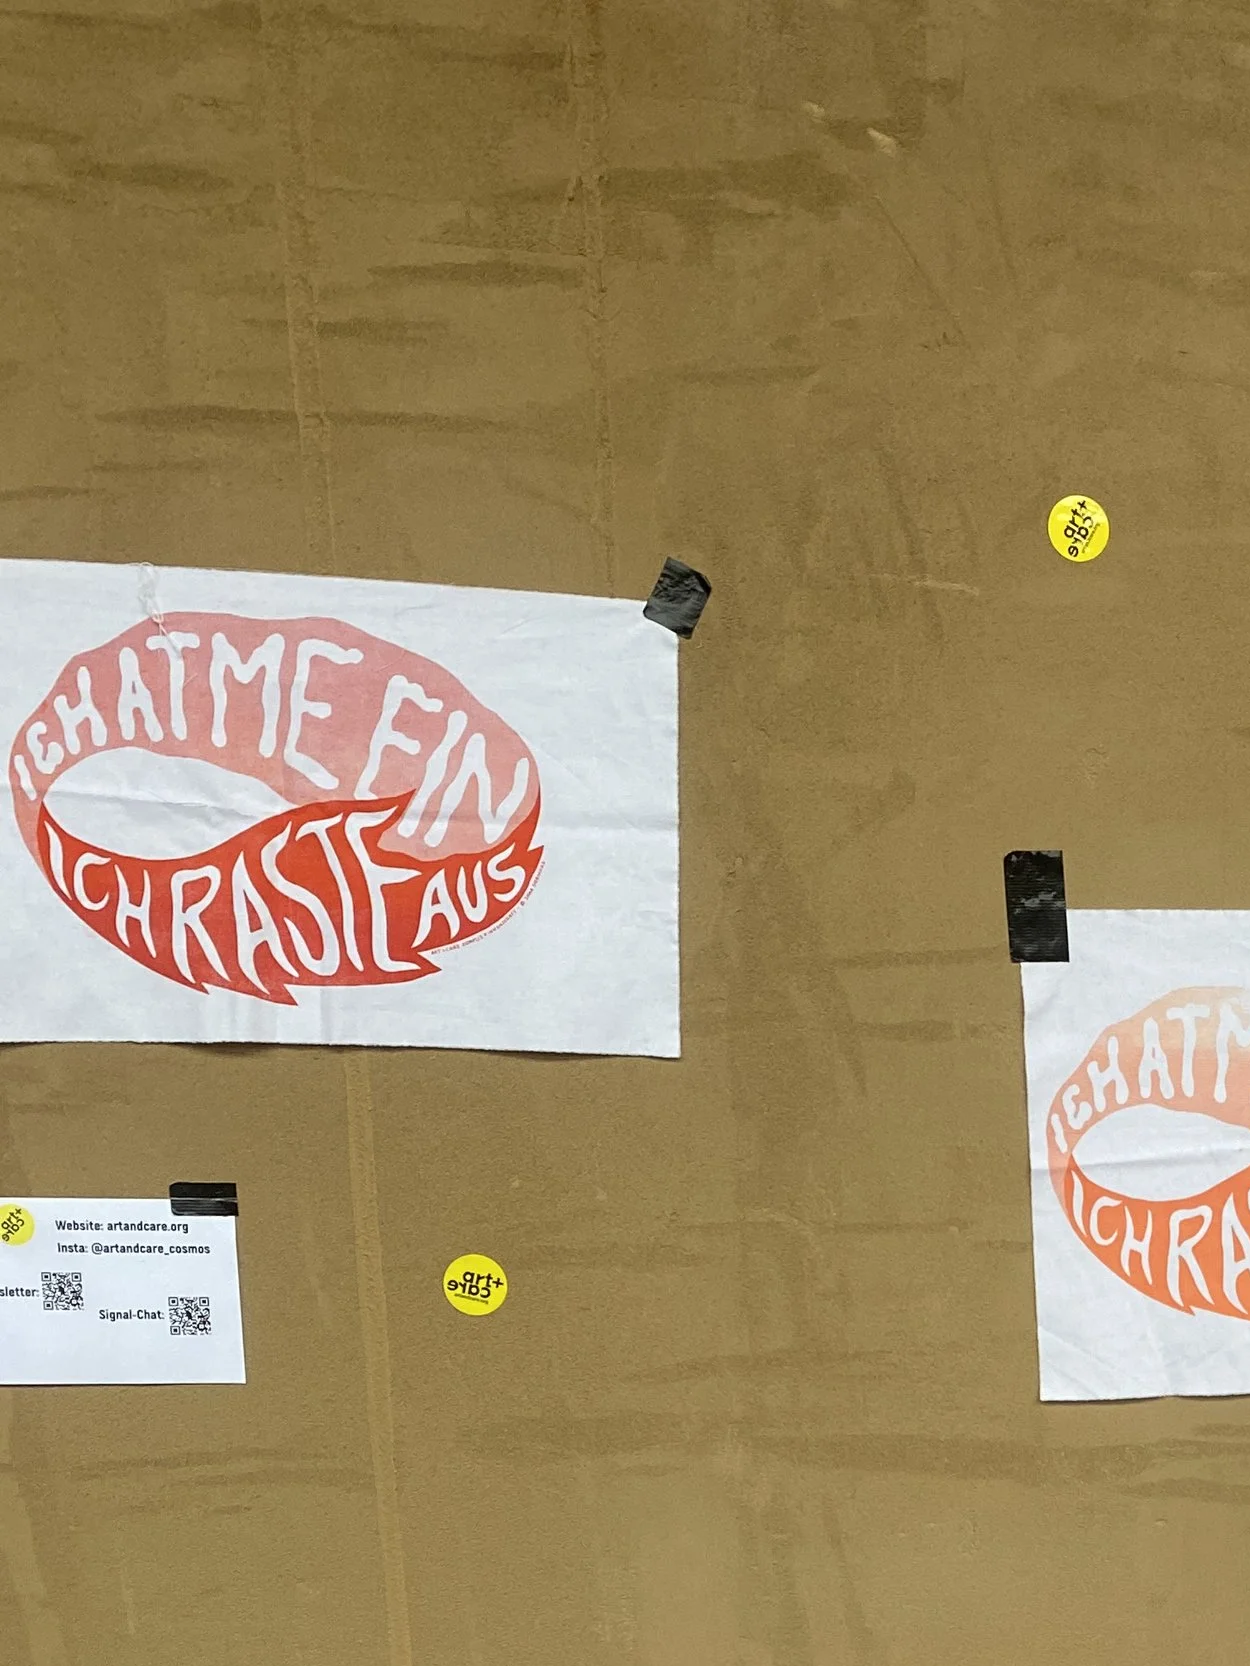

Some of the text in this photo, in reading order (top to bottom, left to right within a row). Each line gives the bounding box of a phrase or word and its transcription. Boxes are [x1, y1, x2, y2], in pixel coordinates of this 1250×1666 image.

[1064, 500, 1087, 538] art+
[411, 843, 528, 950] AUS
[1, 1208, 22, 1230] art+
[55, 1220, 189, 1234] Website: artandcare.org
[57, 1243, 211, 1256] Insta: @artandcare_cosmos
[463, 1271, 504, 1288] art+
[0, 1286, 40, 1297] sletter:
[99, 1310, 165, 1321] Signal-Chat:
